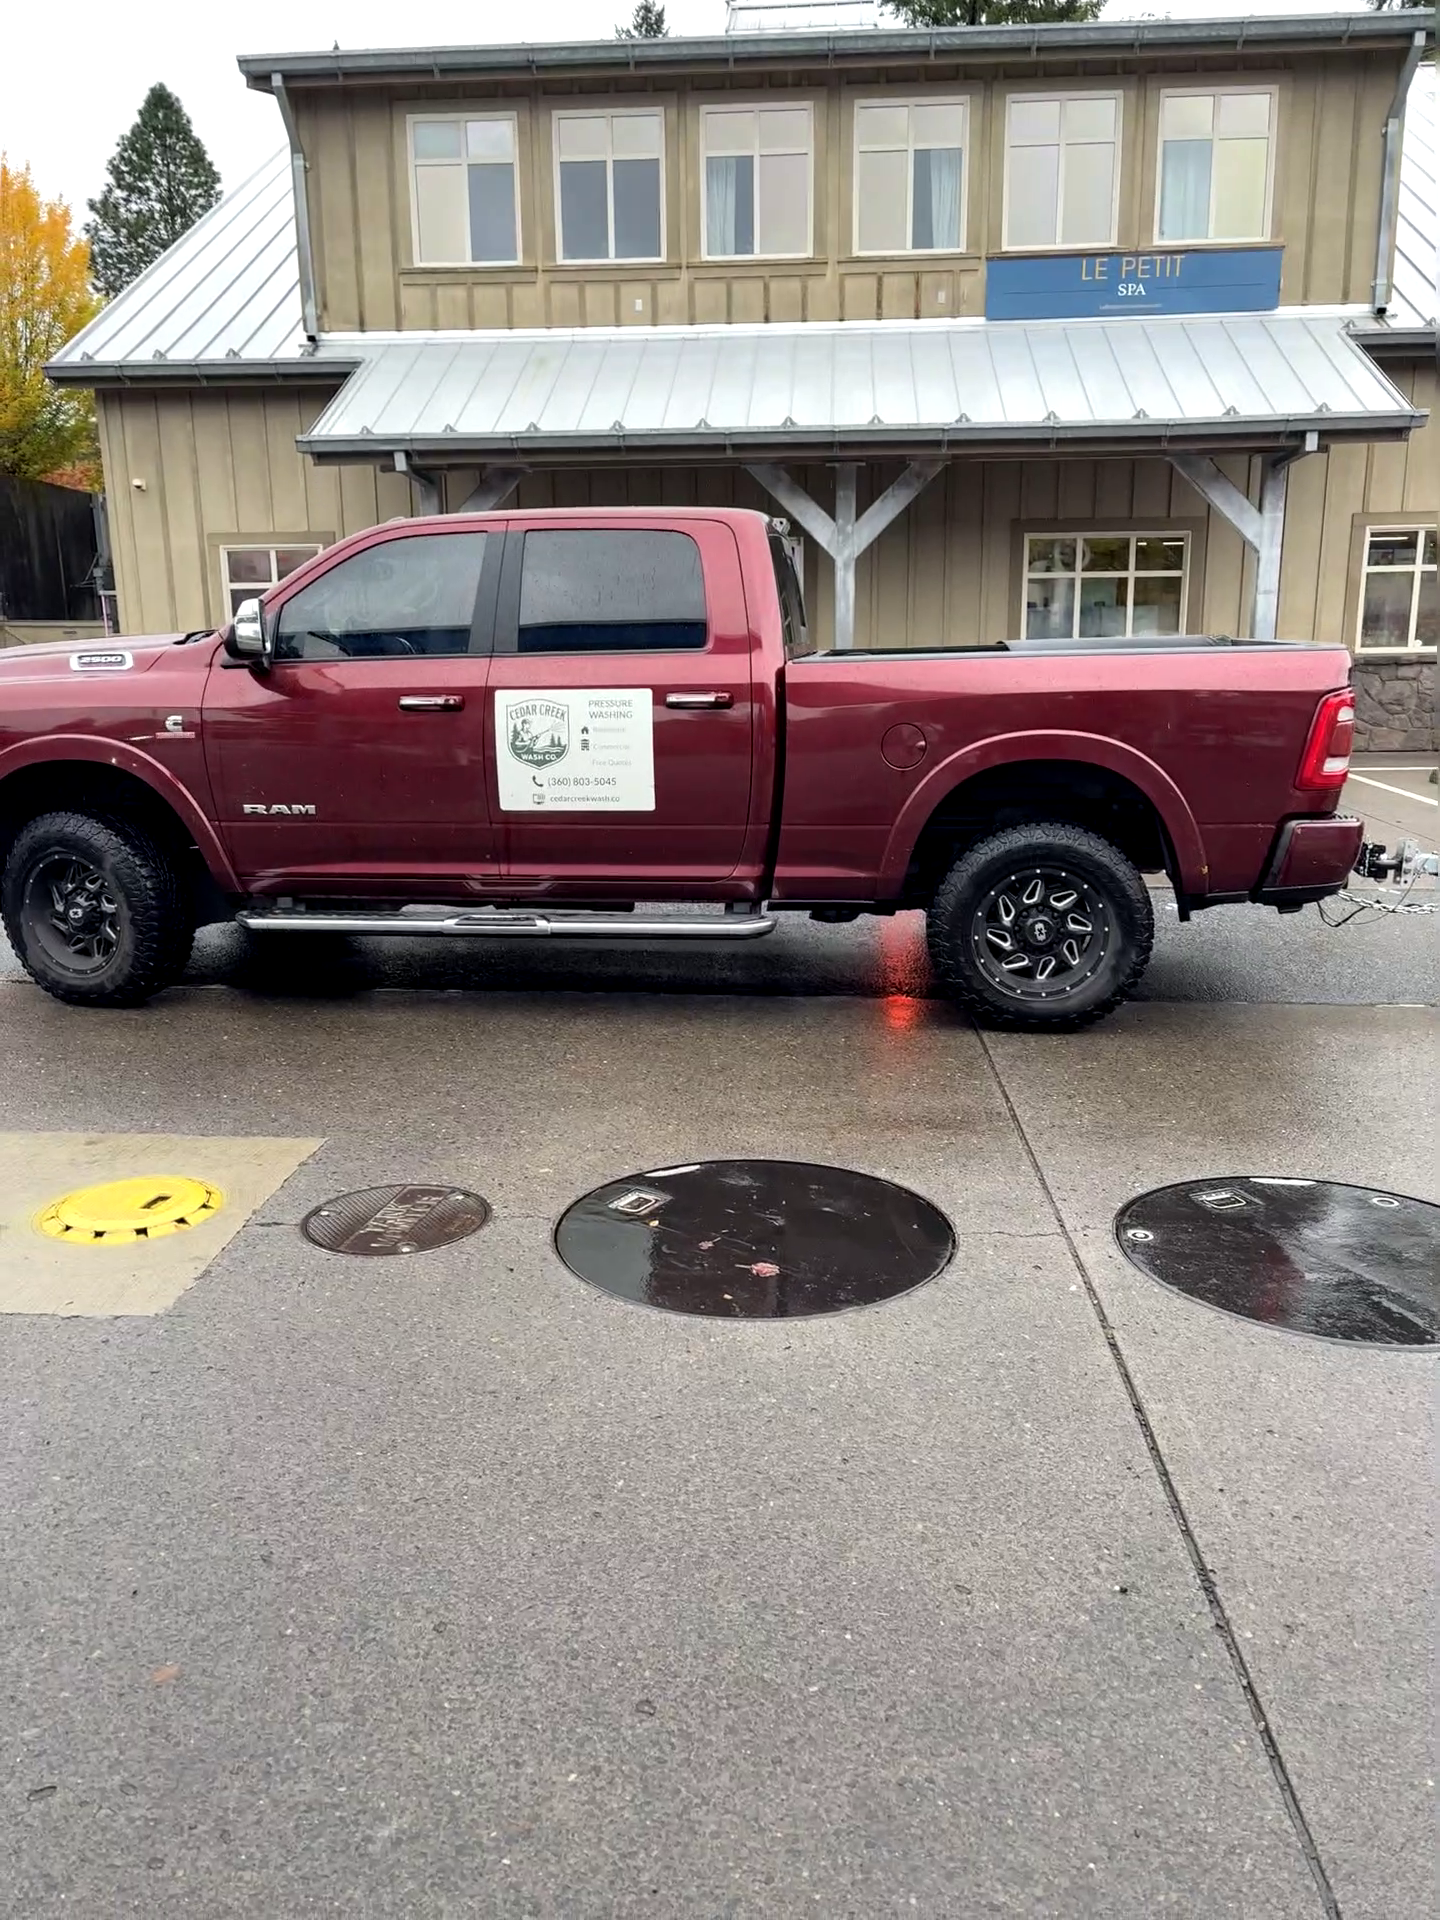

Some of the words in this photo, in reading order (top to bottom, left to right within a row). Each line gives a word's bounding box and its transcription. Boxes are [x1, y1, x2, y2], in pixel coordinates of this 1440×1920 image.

[1081, 258, 1109, 281] LE
[1121, 255, 1186, 279] PETIT
[1117, 283, 1147, 296] SPA
[588, 699, 633, 708] PRESSURE
[509, 704, 538, 722] CEDAR
[539, 703, 567, 722] CREEK
[588, 710, 633, 719] WASHING
[520, 753, 544, 761] WASH
[548, 777, 571, 787] (360)
[573, 777, 617, 787] 803-5045
[549, 794, 620, 803] cedarcreekwash.co
[242, 803, 317, 815] RAM
